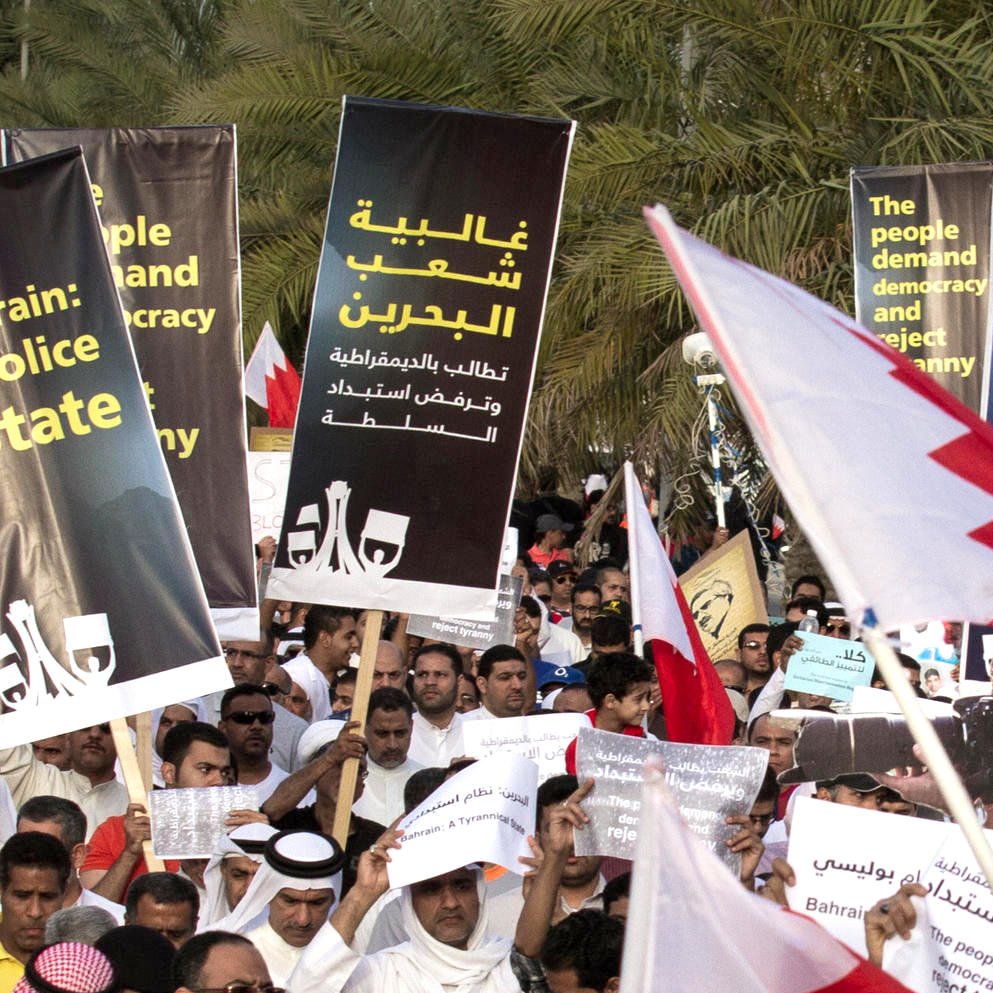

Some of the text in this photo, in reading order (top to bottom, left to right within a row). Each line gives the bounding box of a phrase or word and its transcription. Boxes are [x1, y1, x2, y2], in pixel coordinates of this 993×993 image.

[869, 196, 916, 216] The
[101, 216, 171, 254] ple
[349, 199, 528, 250] غالبية
[871, 220, 959, 248] people
[872, 245, 976, 270] demand
[112, 256, 199, 288] and
[346, 252, 522, 290] شعب
[872, 278, 988, 296] democracy
[338, 292, 516, 340] البحرين
[874, 300, 921, 322] and
[0, 333, 100, 382] olice
[330, 348, 509, 381] تطالب بالديمقراطية
[910, 356, 976, 377] anny
[328, 380, 501, 416] وترفض استبداد
[0, 390, 122, 452] tate
[321, 410, 498, 443] السلطة
[432, 621, 494, 642] reject tyranny
[464, 787, 494, 804] نظام
[448, 820, 456, 830] A
[458, 811, 510, 826] Tyrannical
[608, 826, 638, 842] reje
[814, 860, 895, 884] بوليسي
[806, 898, 867, 920] Bahrai
[930, 926, 952, 946] The
